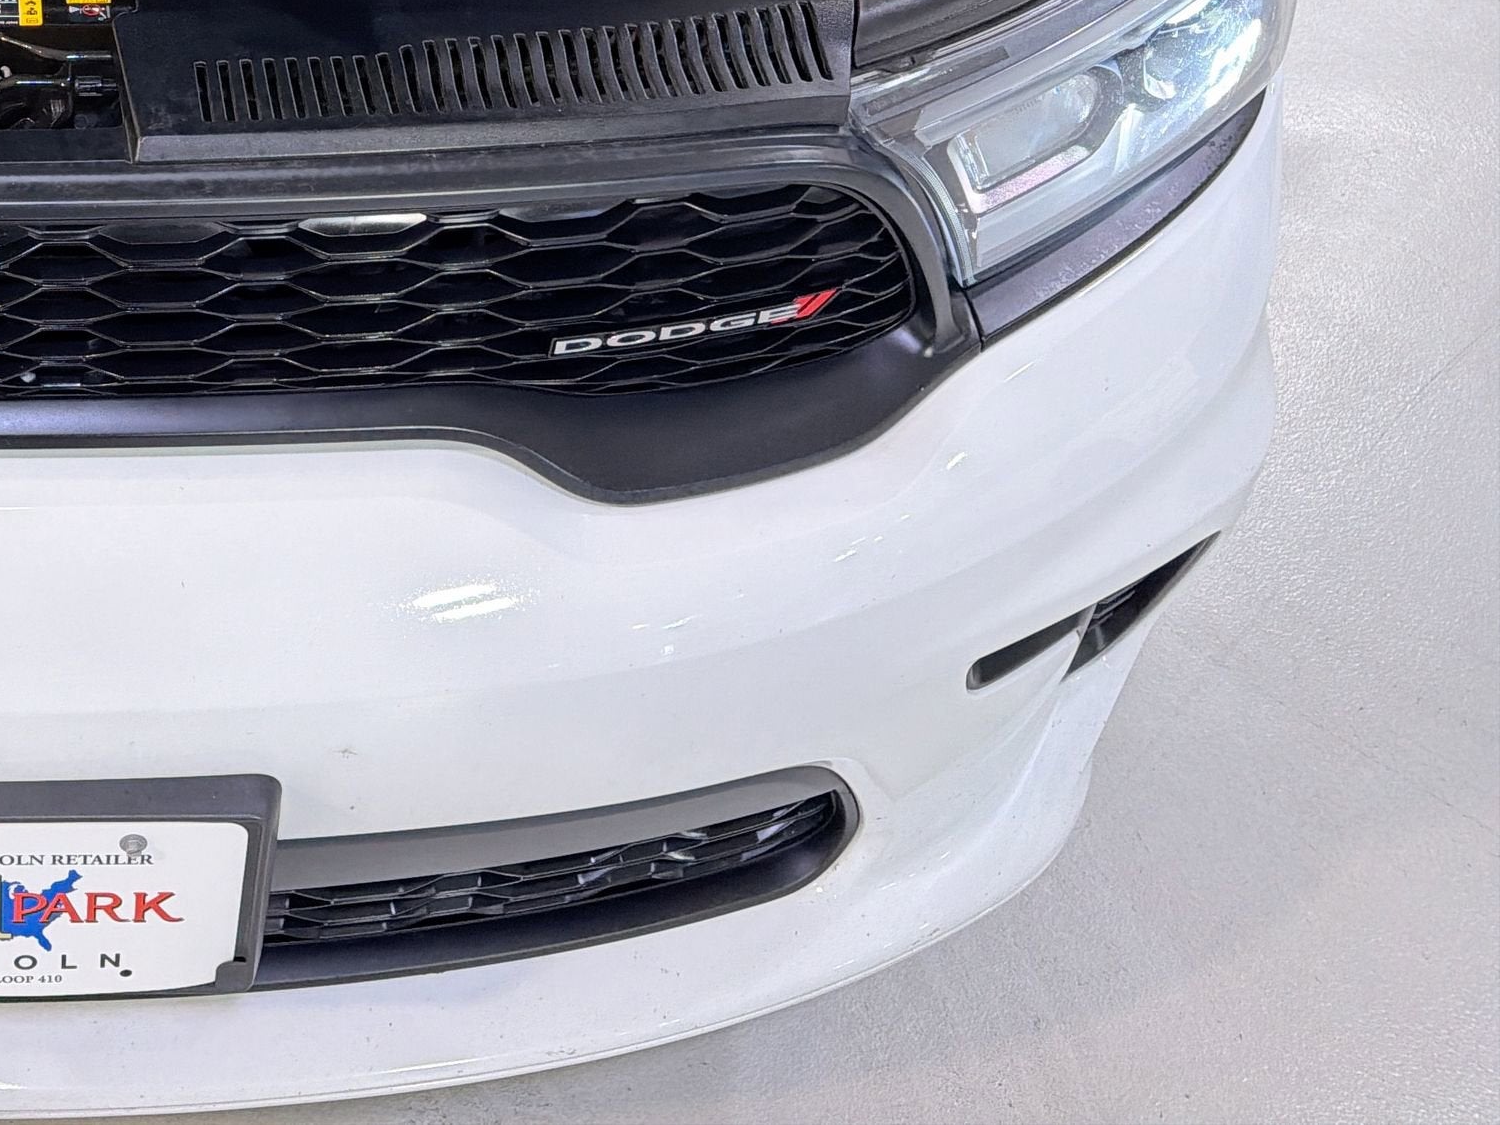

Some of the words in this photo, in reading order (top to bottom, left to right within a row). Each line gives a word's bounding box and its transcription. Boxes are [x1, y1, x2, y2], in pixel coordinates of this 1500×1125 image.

[553, 303, 800, 355] DODGE
[50, 853, 154, 866] RETAILER
[11, 891, 184, 924] PARK
[38, 974, 63, 984] 410
